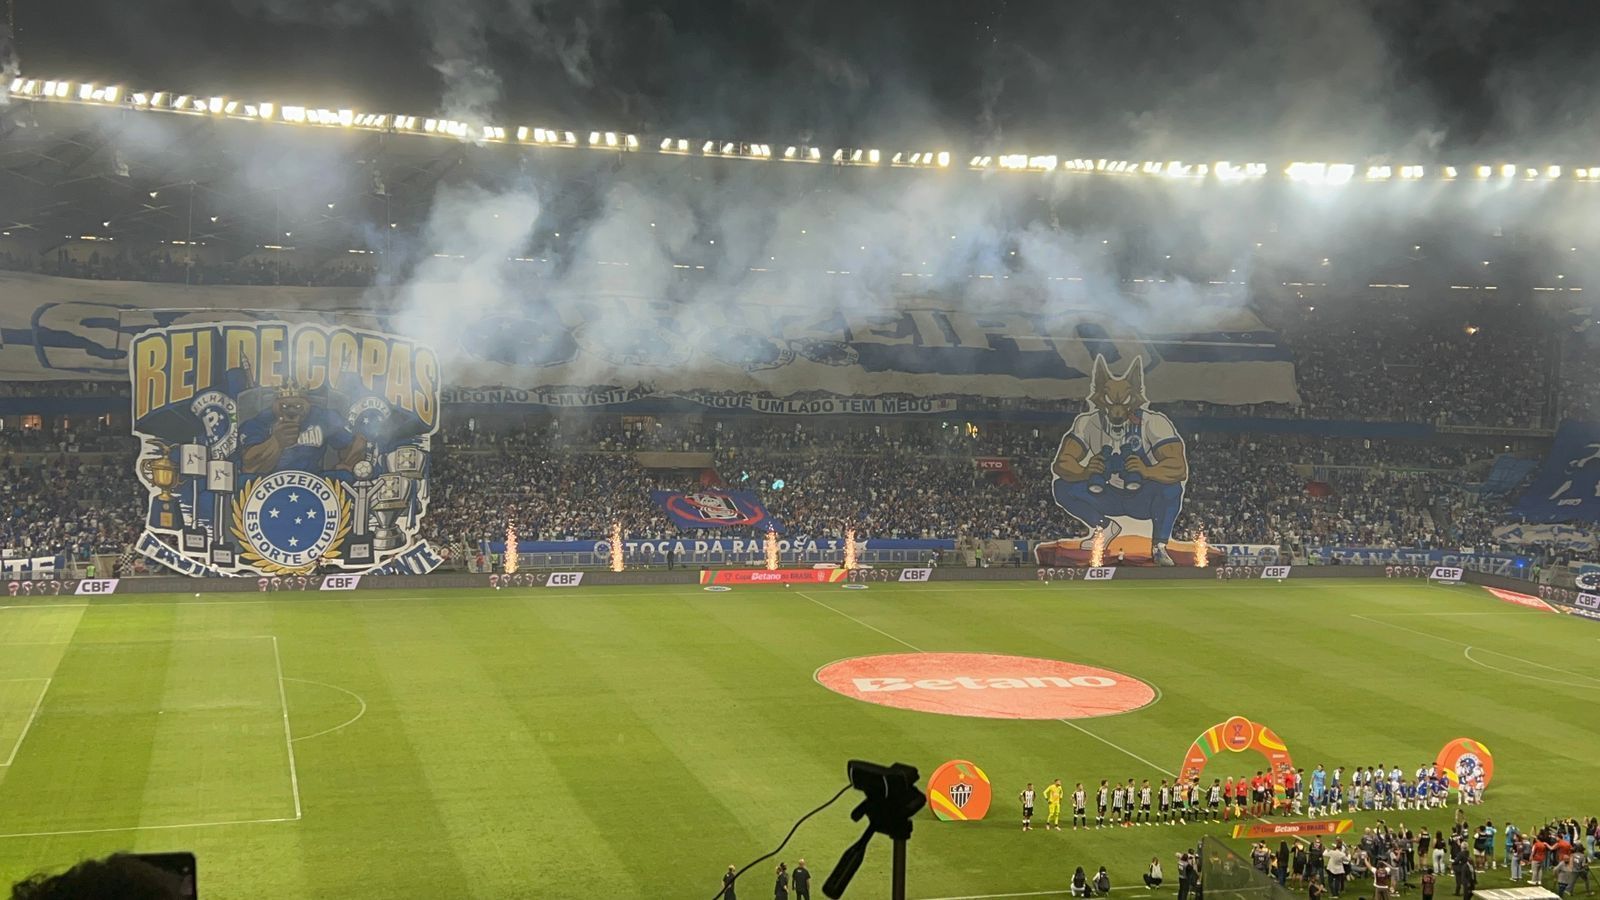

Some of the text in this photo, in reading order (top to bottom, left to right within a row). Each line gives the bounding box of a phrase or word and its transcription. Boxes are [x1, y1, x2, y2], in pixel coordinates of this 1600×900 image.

[135, 329, 213, 420] REI
[225, 326, 286, 389] DE
[295, 329, 437, 427] COPAS
[537, 390, 574, 406] TEM
[757, 400, 785, 413] UM
[787, 400, 835, 414] LADO
[839, 399, 876, 413] TEM
[882, 399, 932, 413] MEDO
[255, 475, 331, 501] CRUZEIRO
[247, 511, 302, 564] ESPORTE
[307, 509, 337, 559] CLUBE
[625, 540, 837, 555] TOCA DA RAOSA 3
[0, 556, 56, 580] TE
[1089, 567, 1112, 579] CBF
[1265, 567, 1286, 577] CBF
[1435, 568, 1459, 578] CBF
[552, 573, 577, 585] CBF
[751, 572, 782, 581] Betano
[903, 570, 926, 580] CBF
[82, 581, 111, 593] CBF
[326, 576, 354, 589] CBF
[1579, 595, 1597, 606] CBF
[851, 675, 1117, 692] Betano
[1274, 825, 1300, 833] Betano
